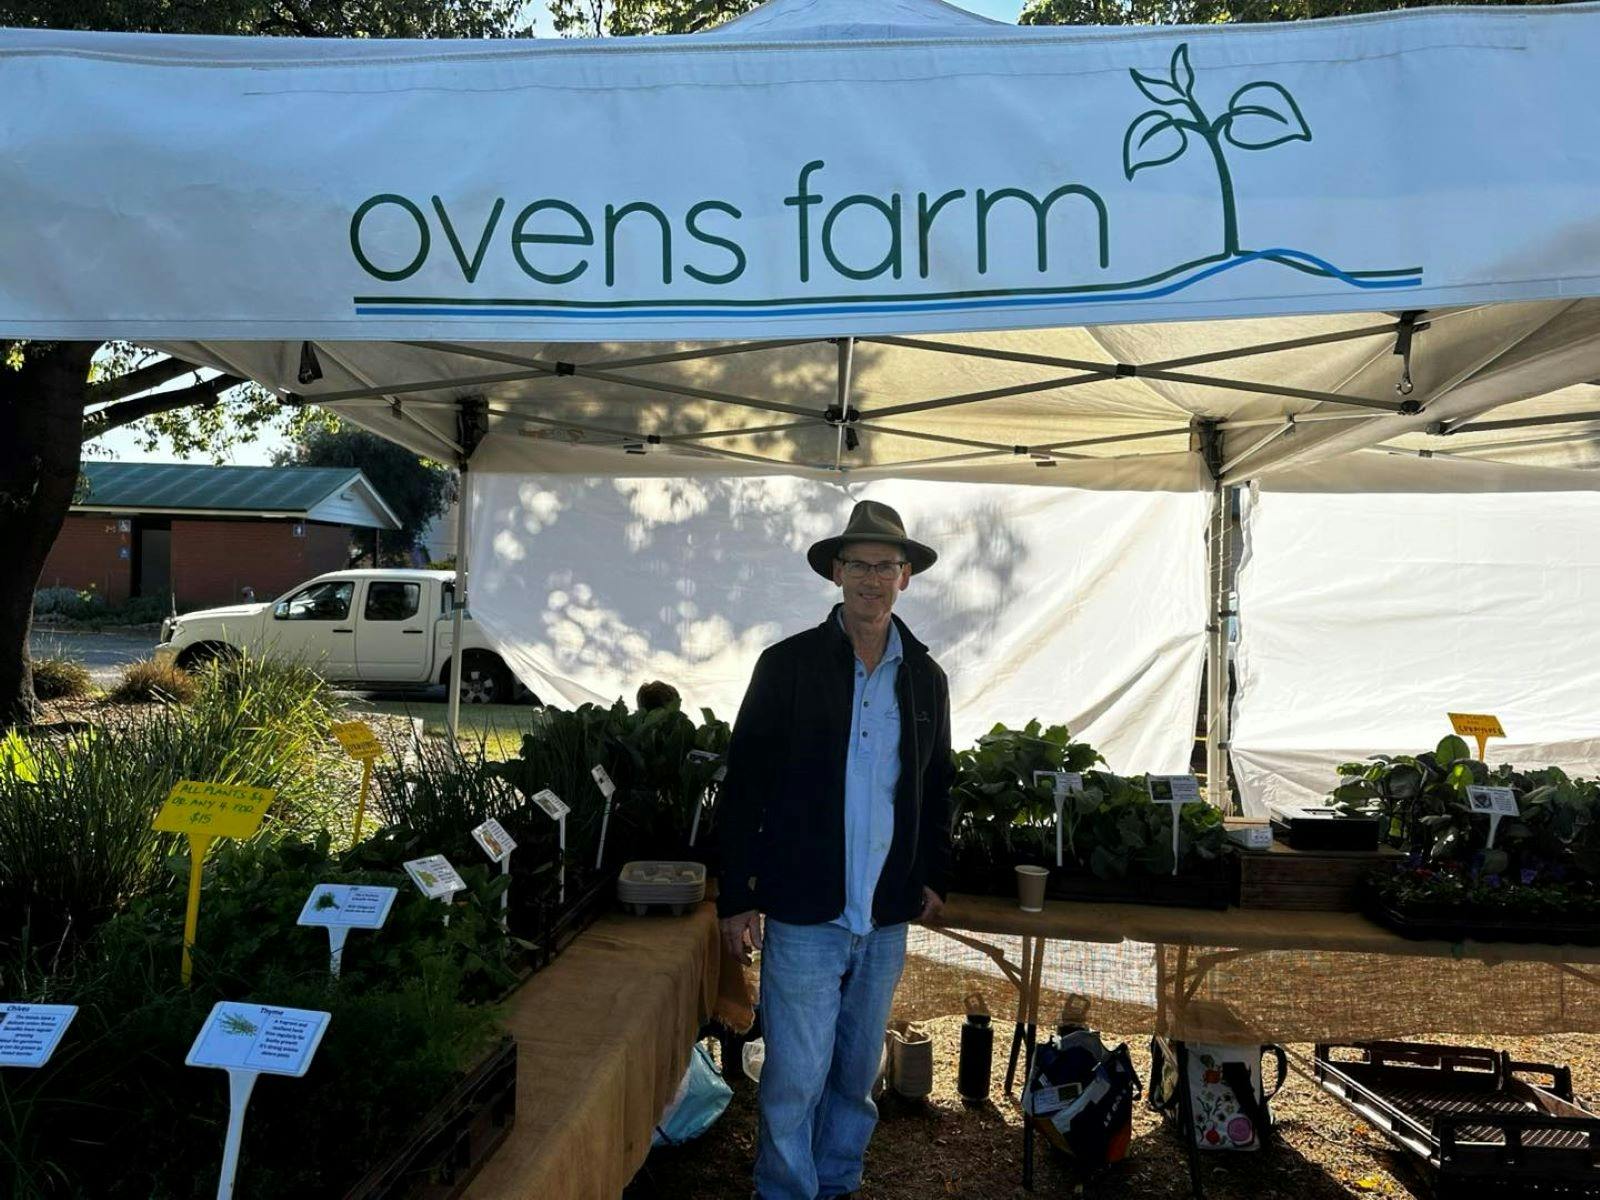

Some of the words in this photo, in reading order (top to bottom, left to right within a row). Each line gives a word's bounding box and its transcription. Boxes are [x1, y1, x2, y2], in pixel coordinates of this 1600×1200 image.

[350, 193, 746, 287] ovens
[784, 160, 1109, 283] farm
[180, 784, 203, 793] ALL
[204, 785, 245, 798] PLANTS
[189, 799, 215, 809] ANY
[190, 811, 212, 824] $15
[260, 1008, 284, 1016] Thyme
